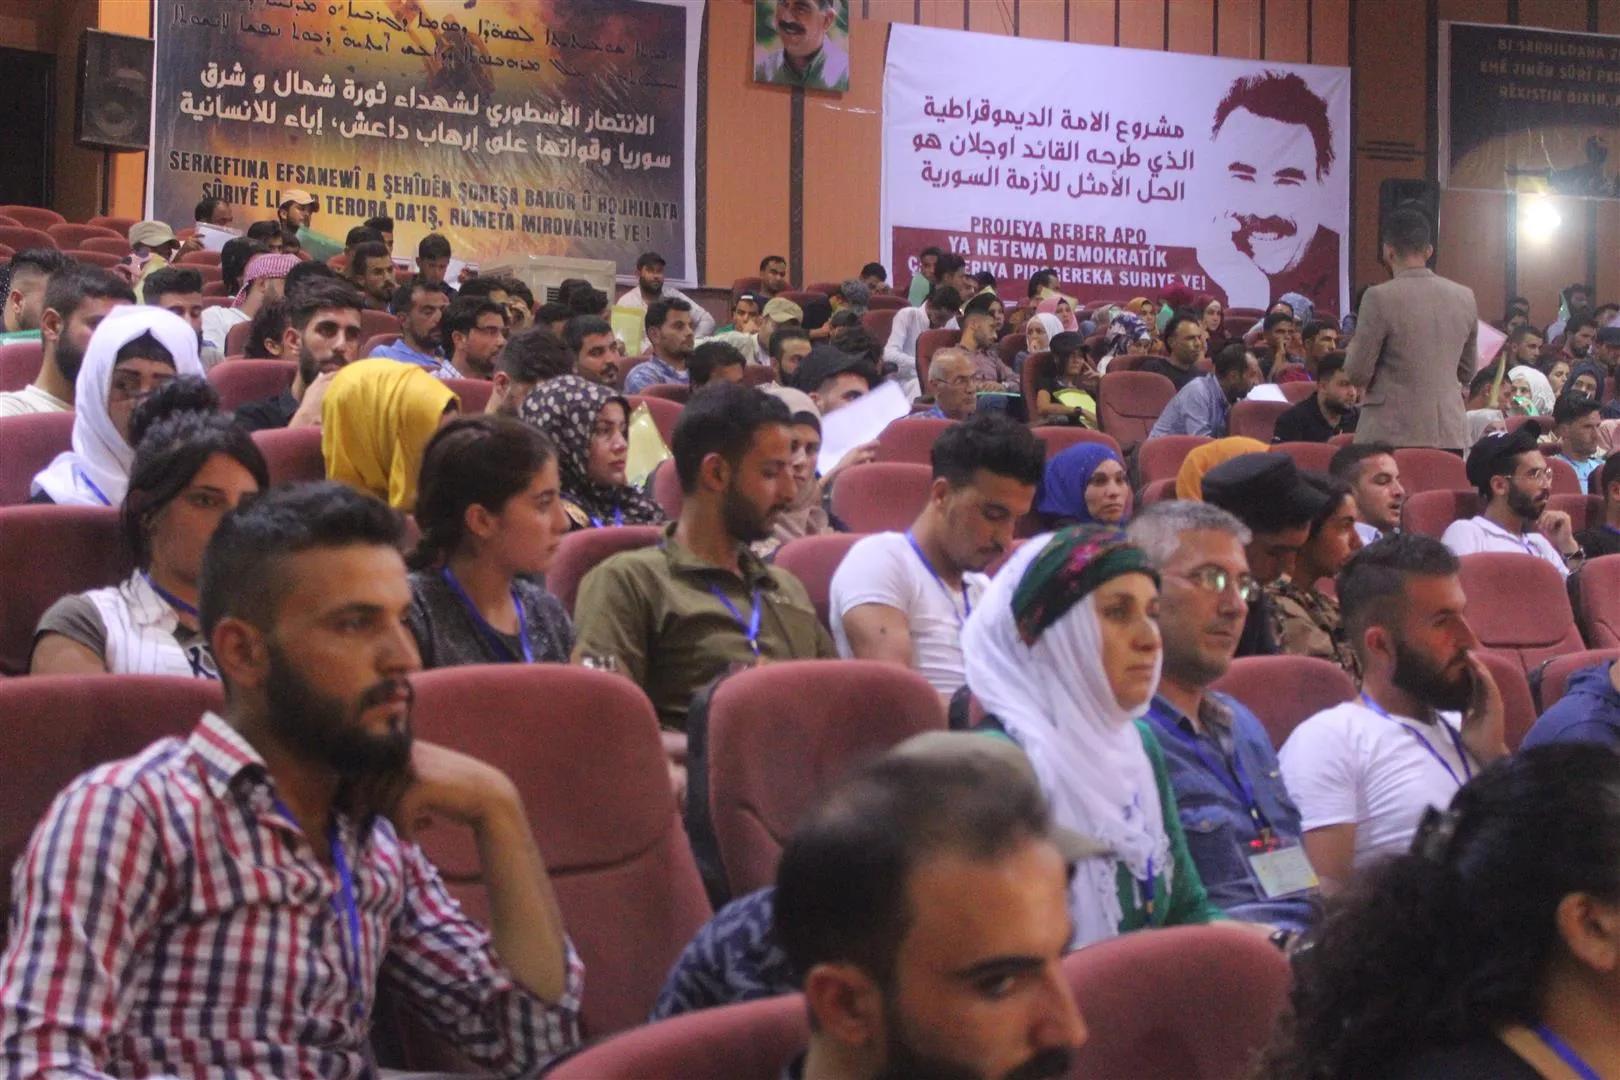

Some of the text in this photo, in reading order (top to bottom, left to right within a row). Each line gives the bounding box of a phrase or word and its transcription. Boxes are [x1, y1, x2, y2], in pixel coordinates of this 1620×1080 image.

[179, 90, 277, 124] للانسانية
[200, 62, 655, 136] الانتصار الأسطوري لشهداء ثورة شمال و شرق
[283, 104, 323, 136] إباء
[923, 95, 1185, 143] مشروع الامة الديموقراطية
[416, 120, 479, 153] إرهاب
[485, 129, 529, 155] على
[537, 133, 612, 167] وقواتها
[618, 142, 672, 170] سوريا
[912, 131, 1195, 180] الذي طرحه القائد اوجلان هو
[169, 151, 678, 220] SERKEFTINA EFSANEWÎ A ŞEHÎDÊN ŞOREŞA BAKÛR Û ROJHILATA
[921, 160, 1186, 204] الحل الأمثل للأزمة السورية
[202, 178, 259, 206] SÛRIYÊ
[266, 188, 280, 209] LI
[326, 195, 388, 218] TERORA
[450, 207, 515, 231] RUMETA
[521, 214, 617, 241] MIROVAHIYÊ
[623, 224, 640, 242] YE
[970, 216, 1147, 245] PROJEYA REBER APO
[948, 236, 1168, 268] YA NETEWA DEMOKRATÎK
[1181, 274, 1206, 291] YE!
